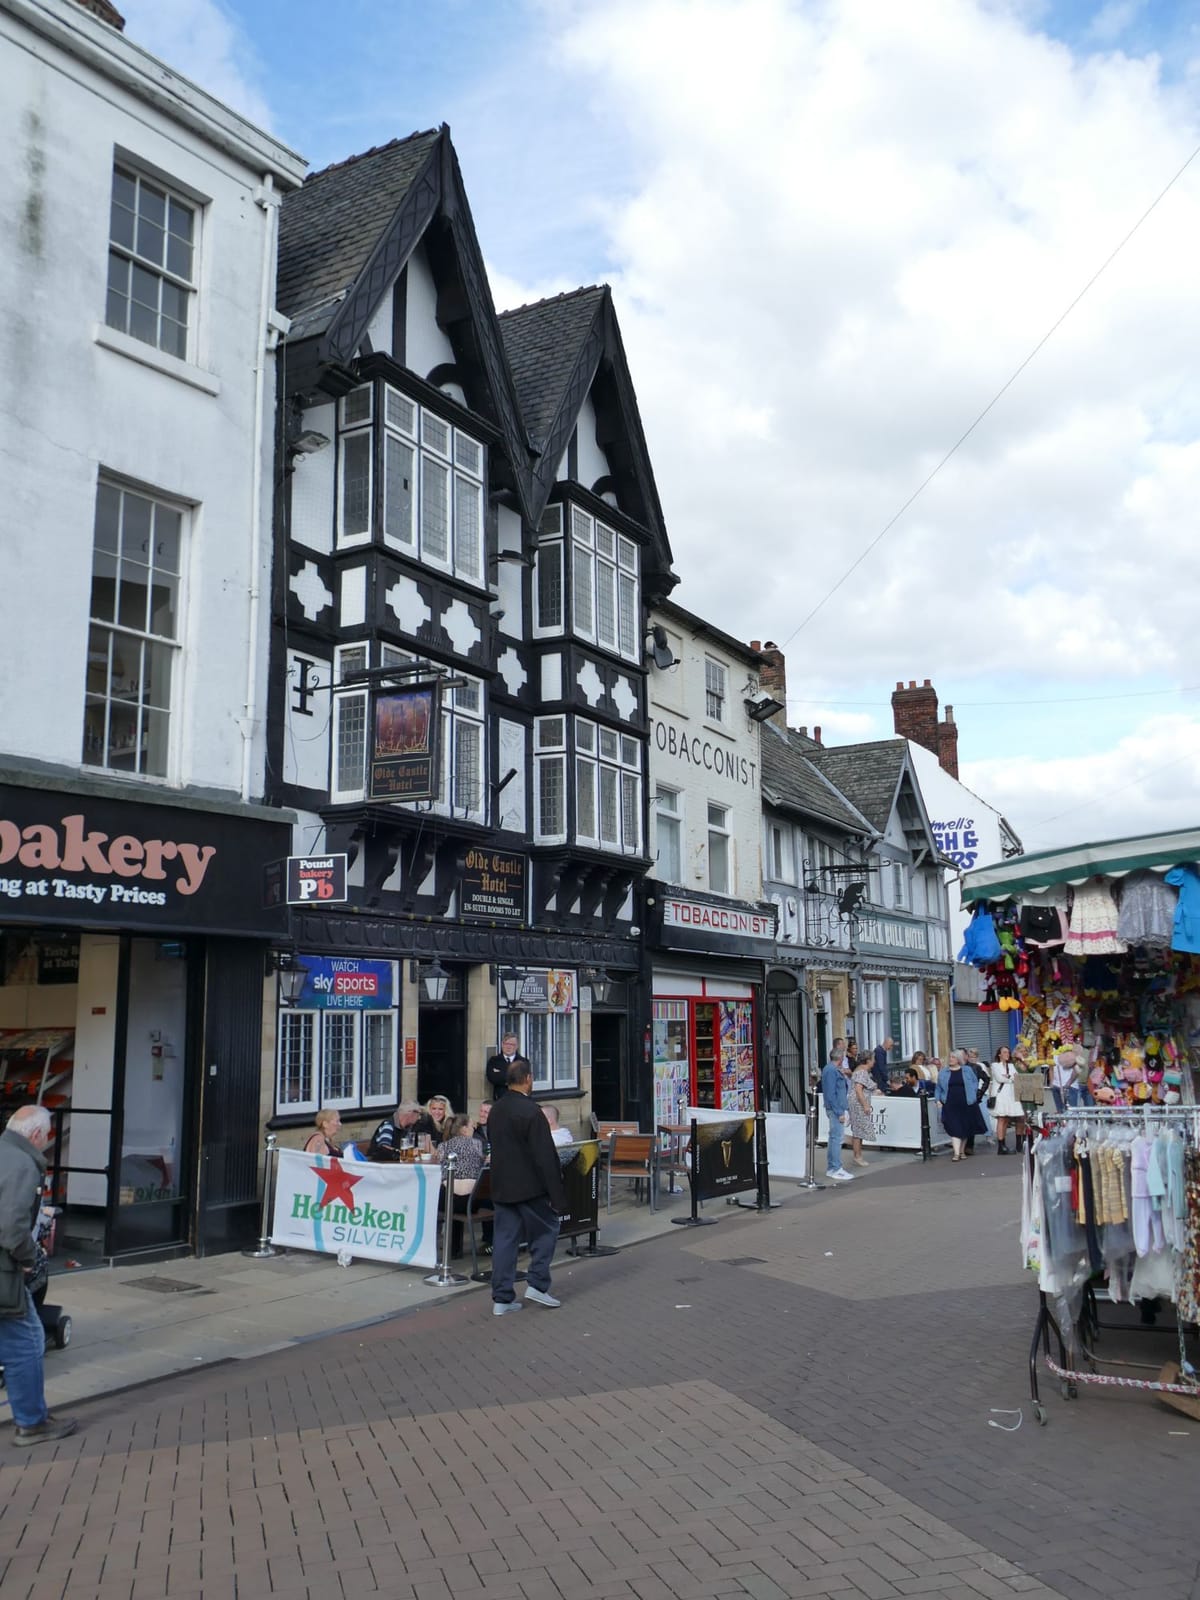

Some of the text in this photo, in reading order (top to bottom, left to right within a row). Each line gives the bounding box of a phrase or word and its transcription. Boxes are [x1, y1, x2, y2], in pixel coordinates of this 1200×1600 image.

[299, 858, 334, 869] Pound
[465, 851, 522, 876] Olde Castle
[299, 869, 334, 879] bakery
[481, 872, 508, 893] Hotel
[25, 879, 49, 896] at
[52, 878, 107, 904] Tasty
[110, 884, 167, 906] Prices
[299, 879, 334, 899] Pb
[464, 903, 487, 912] EN-SUITE
[488, 905, 505, 914] ROOMS
[512, 908, 521, 916] LET
[472, 894, 492, 903] DOUBLE
[497, 896, 514, 906] SINGLE
[672, 903, 769, 934] TOBACCONIST
[331, 961, 359, 972] WATCH
[313, 973, 376, 993] sky sports
[326, 994, 363, 1007] LIVE HERE
[291, 1193, 406, 1232] Heineken
[332, 1226, 406, 1250] SILVER
